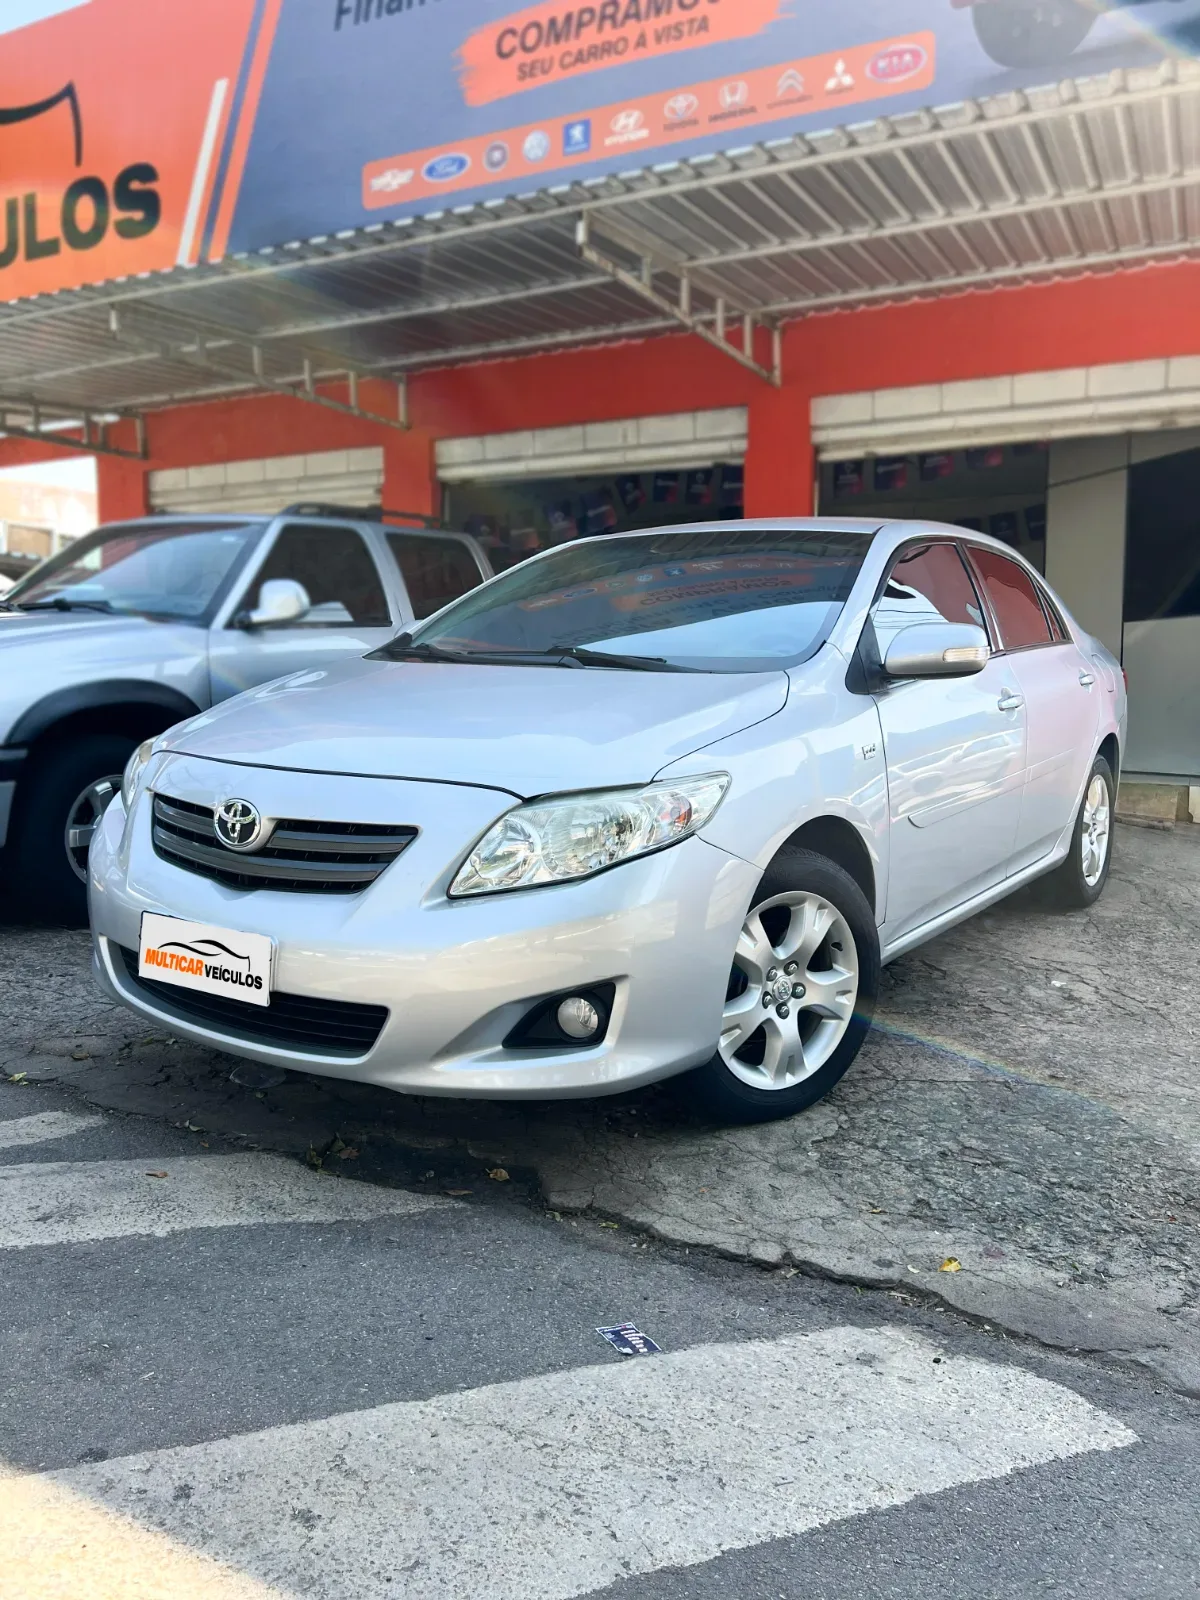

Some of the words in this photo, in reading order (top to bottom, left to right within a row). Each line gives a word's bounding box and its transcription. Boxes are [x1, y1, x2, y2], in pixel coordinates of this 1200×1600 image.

[495, 0, 719, 60] COMPRAM
[517, 56, 554, 82] SEU
[559, 36, 629, 70] CARRO
[654, 15, 710, 45] VISTA
[145, 948, 204, 976] MULTICAR
[204, 964, 263, 989] VEÍCULOS
